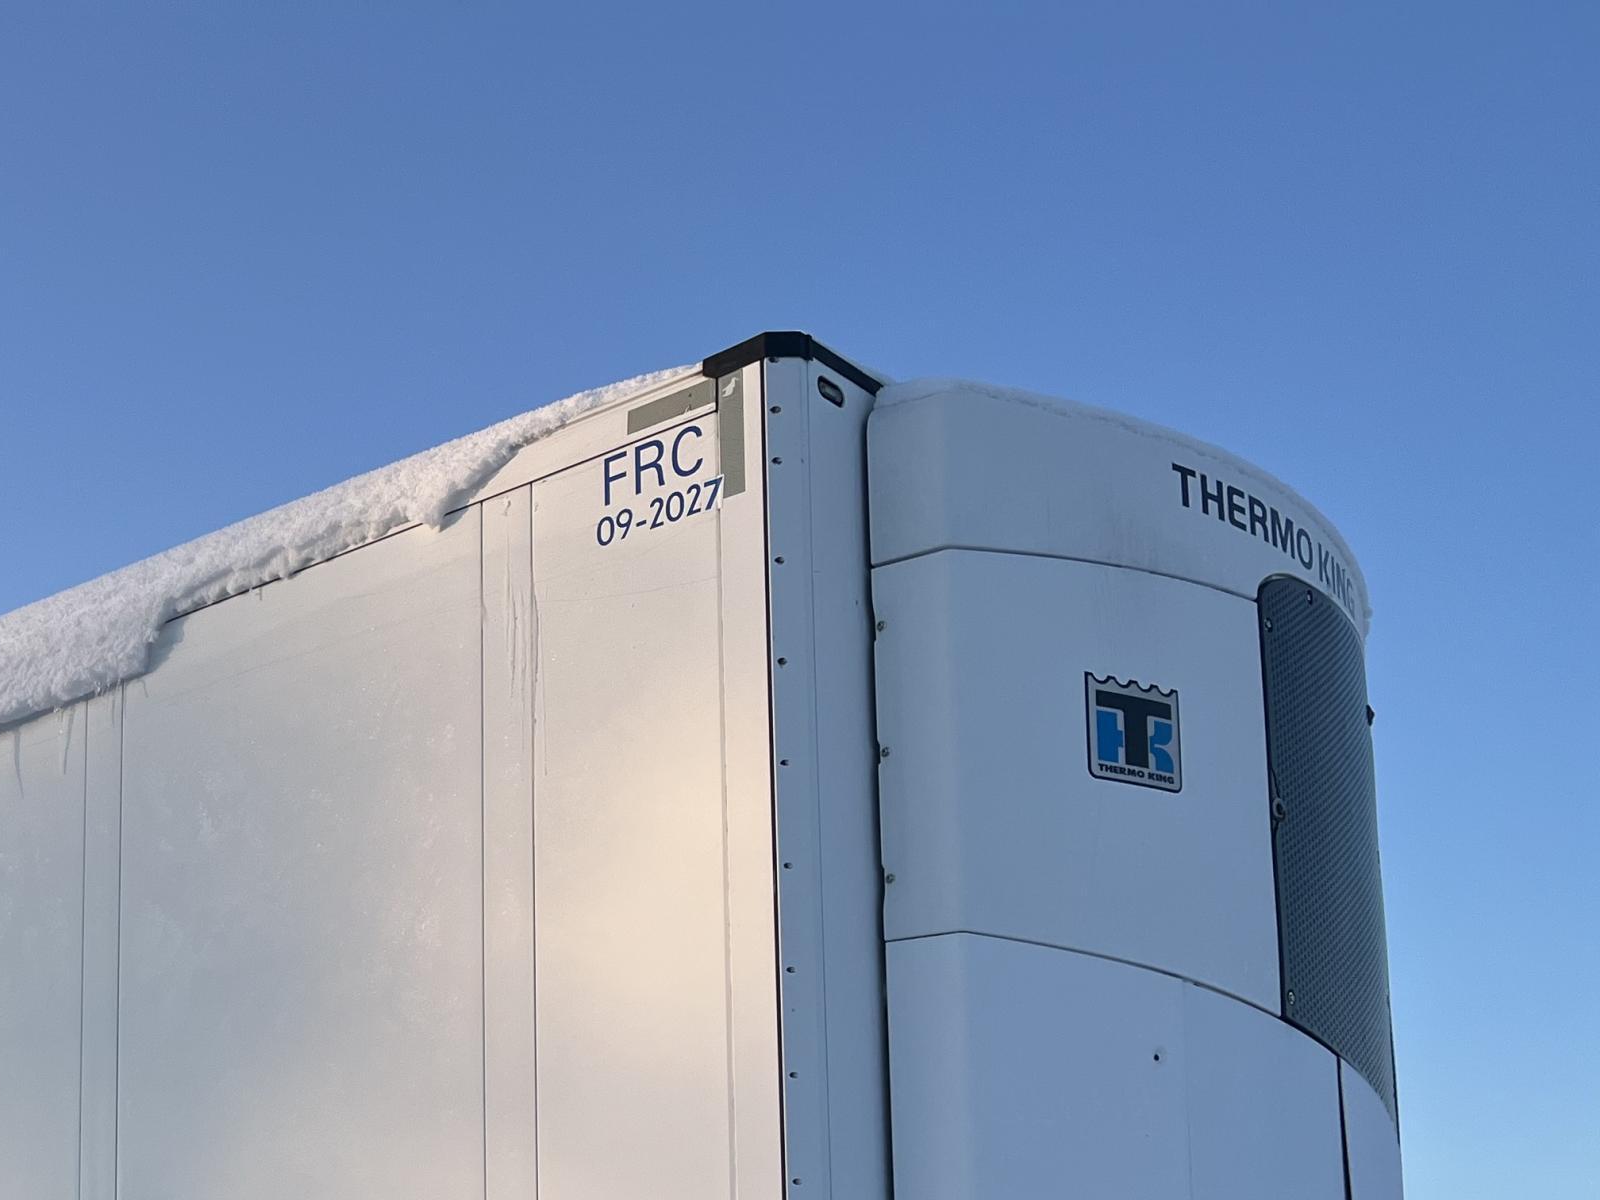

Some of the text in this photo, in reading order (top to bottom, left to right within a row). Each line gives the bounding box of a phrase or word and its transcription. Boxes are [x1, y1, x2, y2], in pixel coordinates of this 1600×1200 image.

[603, 425, 704, 506] FRC
[596, 476, 723, 546] 09-2027
[1171, 462, 1356, 622] THERMO KING
[1098, 763, 1175, 785] THERMO KING
